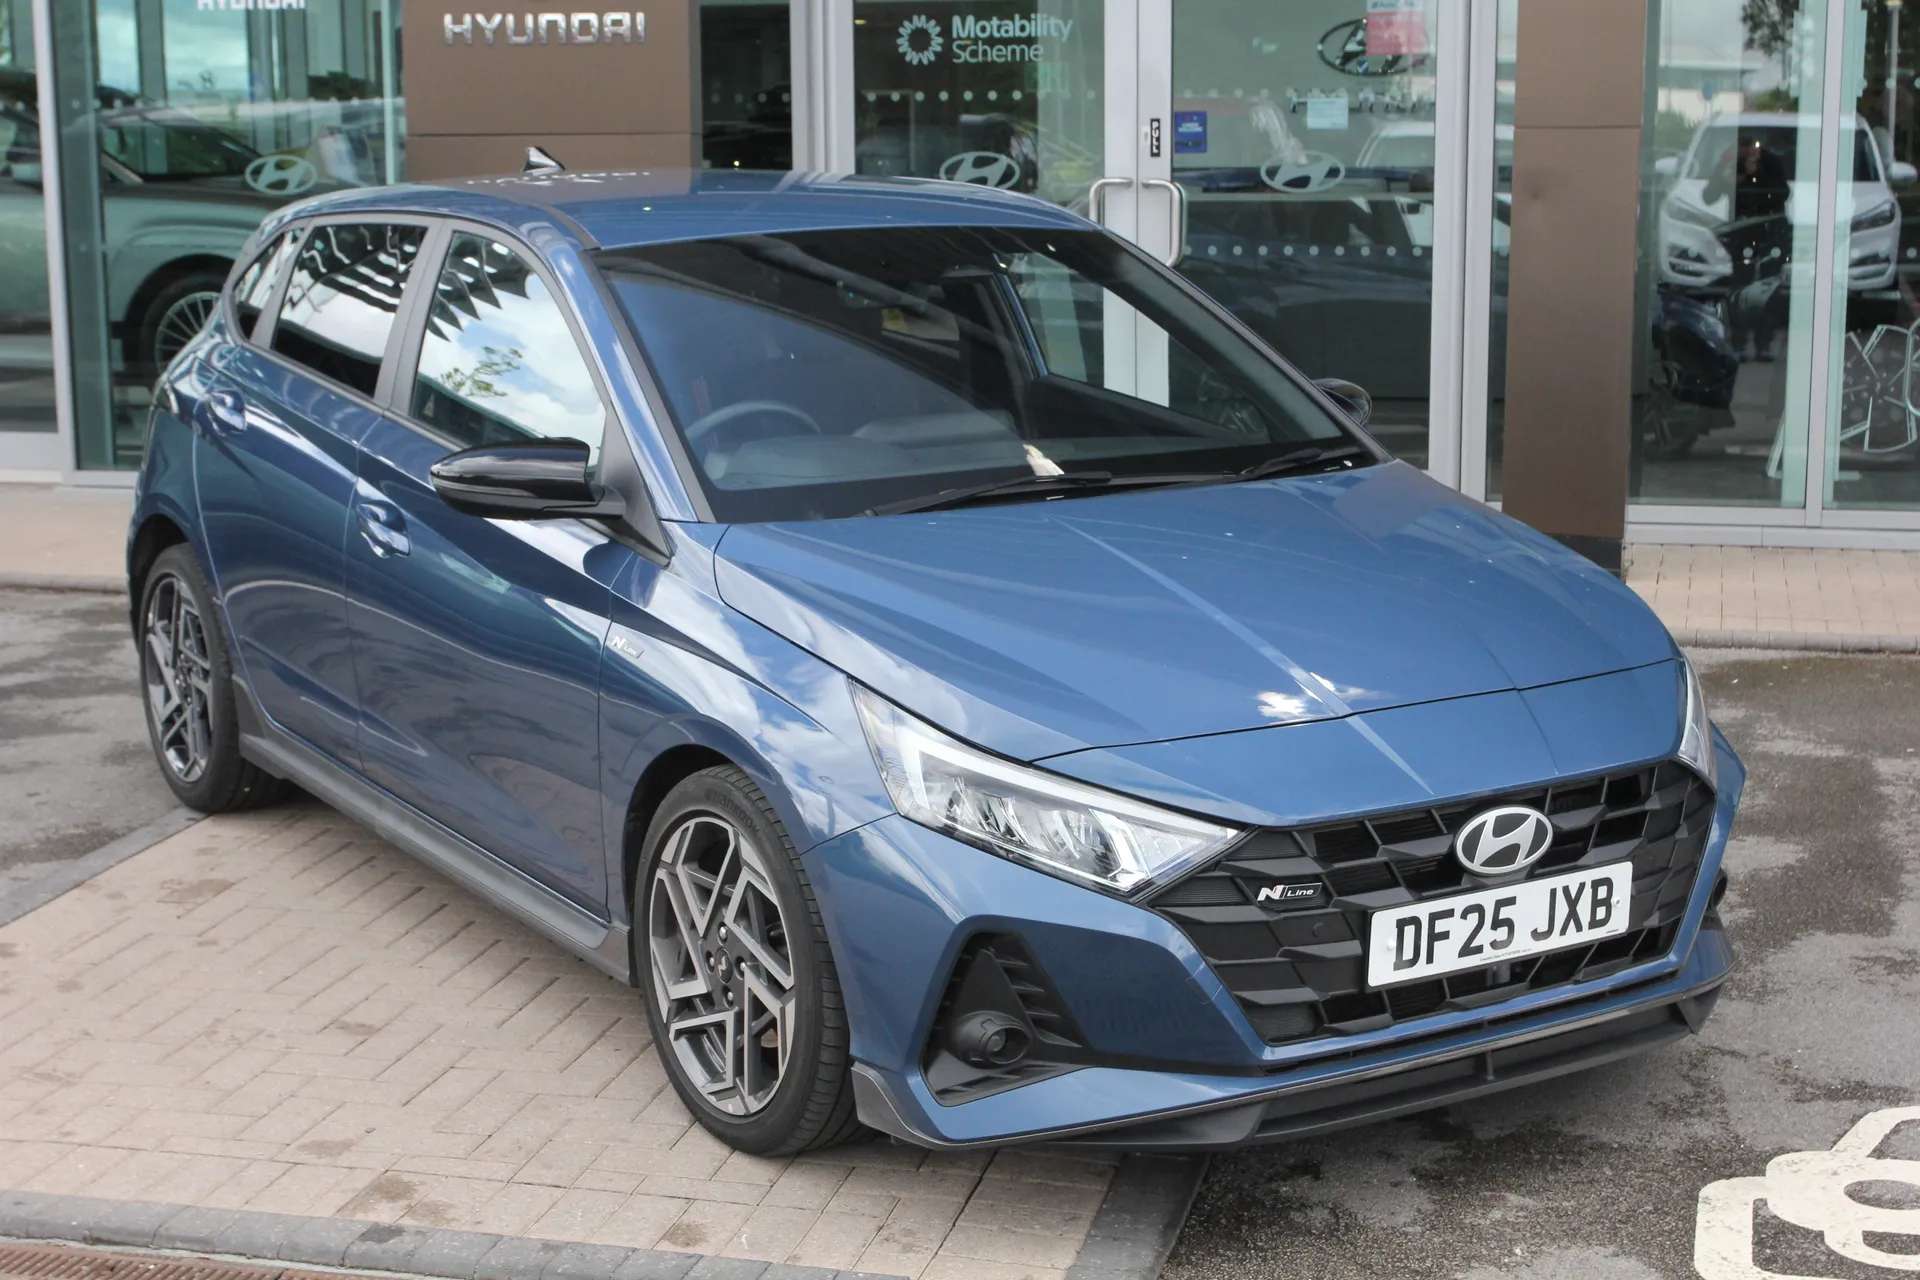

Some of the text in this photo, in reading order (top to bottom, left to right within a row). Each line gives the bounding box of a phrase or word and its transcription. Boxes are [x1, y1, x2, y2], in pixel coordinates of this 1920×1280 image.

[443, 12, 645, 44] HYUNDAI
[952, 14, 1072, 41] Motability
[952, 40, 1044, 63] Scheme
[1151, 121, 1160, 154] PULL
[1393, 877, 1614, 971] DF25 JXB
